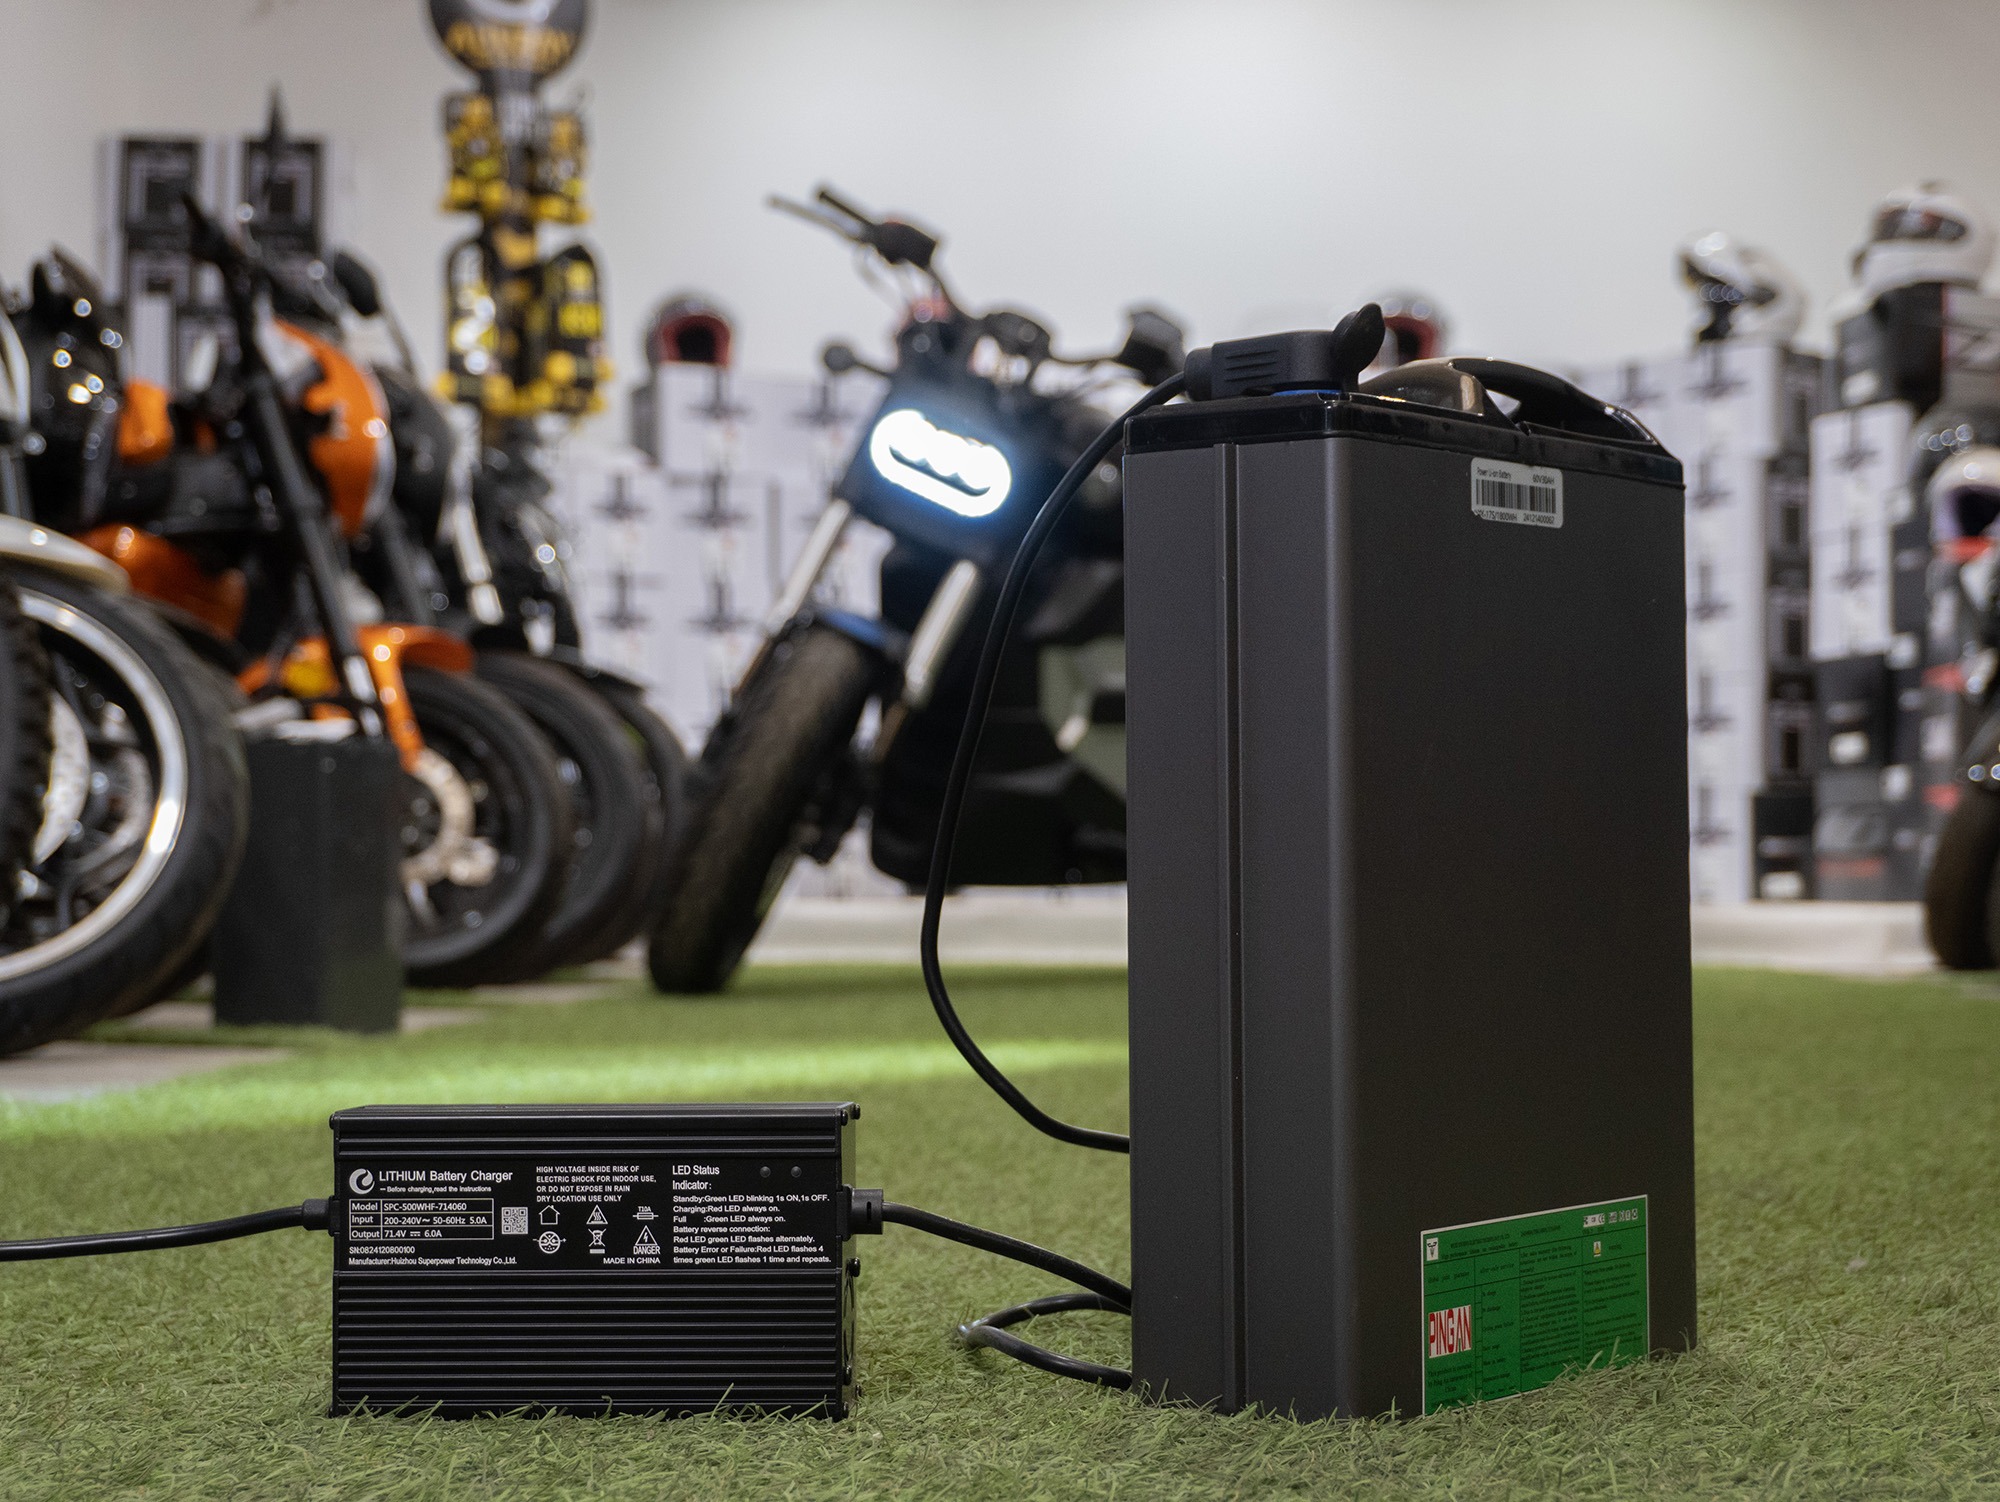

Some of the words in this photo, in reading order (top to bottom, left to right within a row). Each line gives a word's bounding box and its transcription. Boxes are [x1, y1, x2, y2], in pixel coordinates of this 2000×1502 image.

[673, 1165, 690, 1175] LED
[693, 1165, 720, 1175] Status
[379, 1170, 426, 1181] LITHIUM
[430, 1170, 467, 1183] Battery
[470, 1170, 513, 1183] Charger
[641, 1175, 656, 1183] USE,
[673, 1180, 712, 1189] Indicator:
[746, 1195, 773, 1203] blinking
[352, 1203, 378, 1211] Model
[384, 1203, 467, 1211] SPC-500WHF-714060
[742, 1205, 767, 1213] always
[352, 1216, 373, 1224] Input
[748, 1215, 773, 1223] always
[673, 1226, 699, 1234] Battery
[352, 1230, 379, 1239] Output
[633, 1246, 660, 1254] DANGER
[674, 1246, 699, 1254] Battery
[418, 1257, 455, 1266] Superpower
[456, 1257, 492, 1265] Technology
[1429, 1306, 1471, 1357] PINGAN
